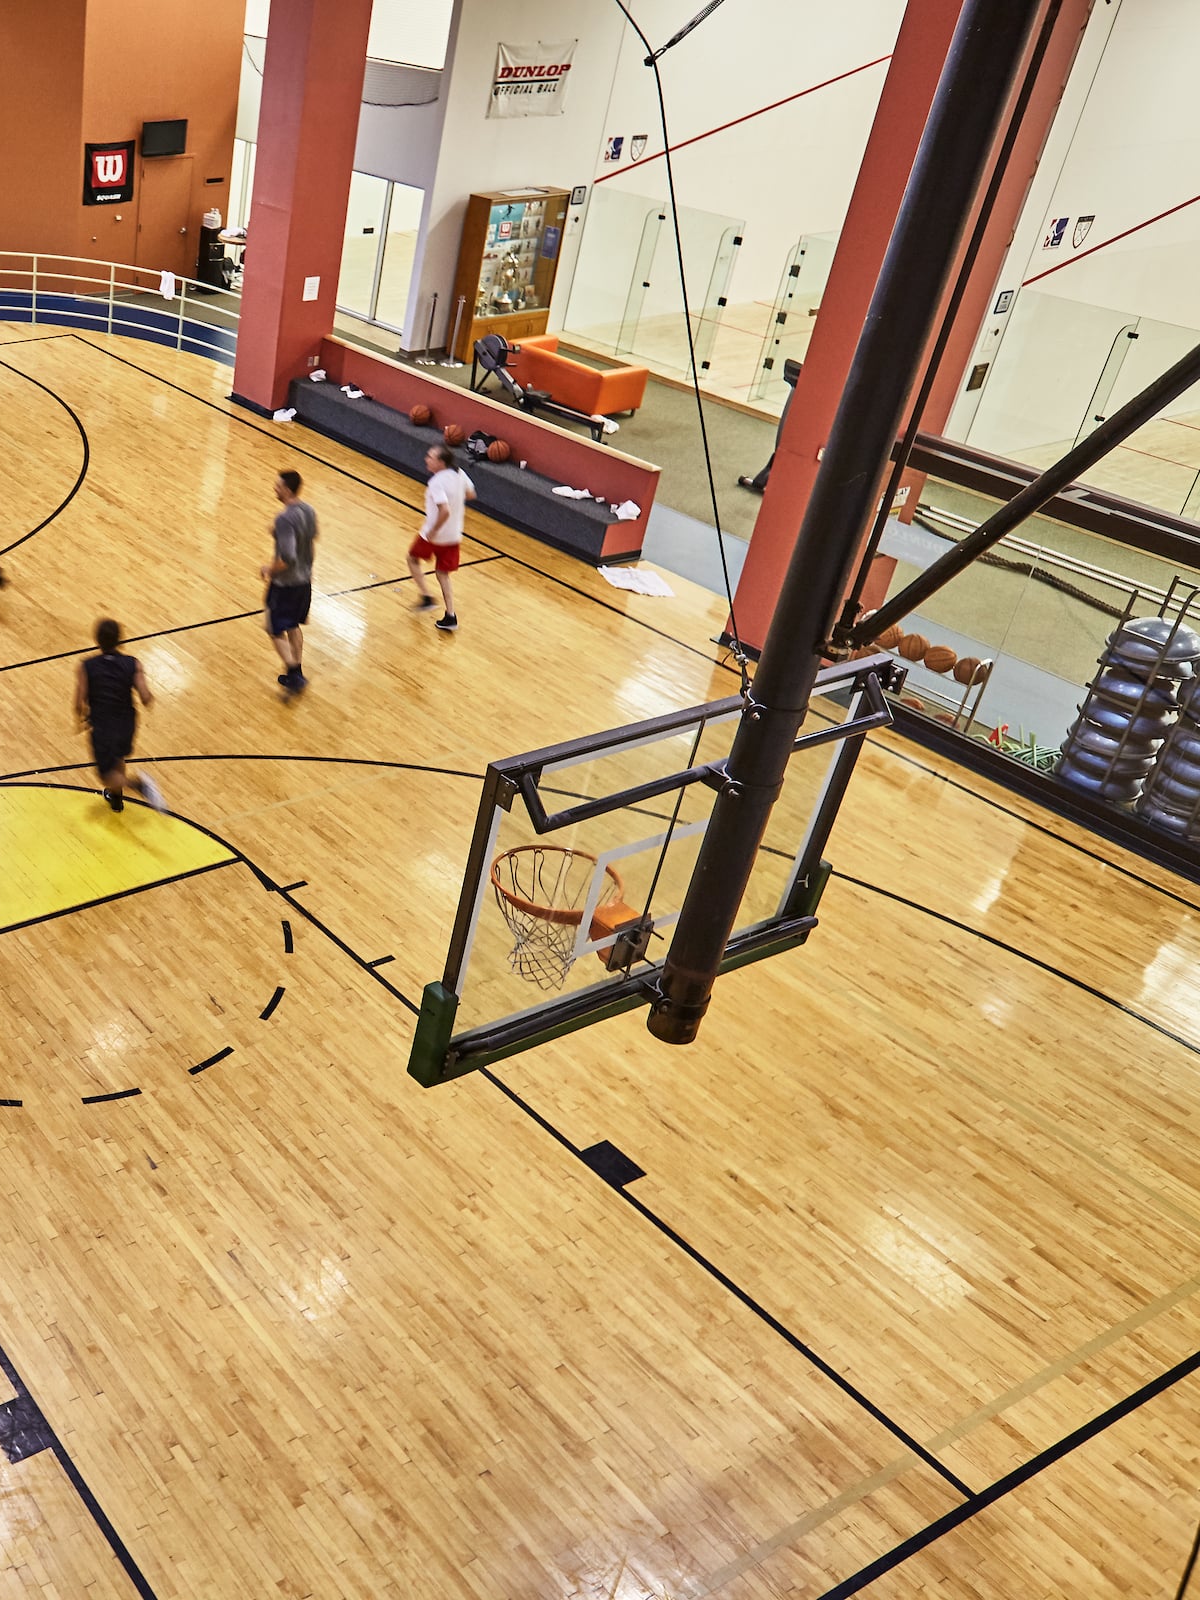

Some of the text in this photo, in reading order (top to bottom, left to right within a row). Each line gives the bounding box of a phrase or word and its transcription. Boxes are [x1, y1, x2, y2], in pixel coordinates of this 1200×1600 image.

[498, 63, 571, 79] DUNLOP
[494, 83, 558, 96] OFFICIAL BALL
